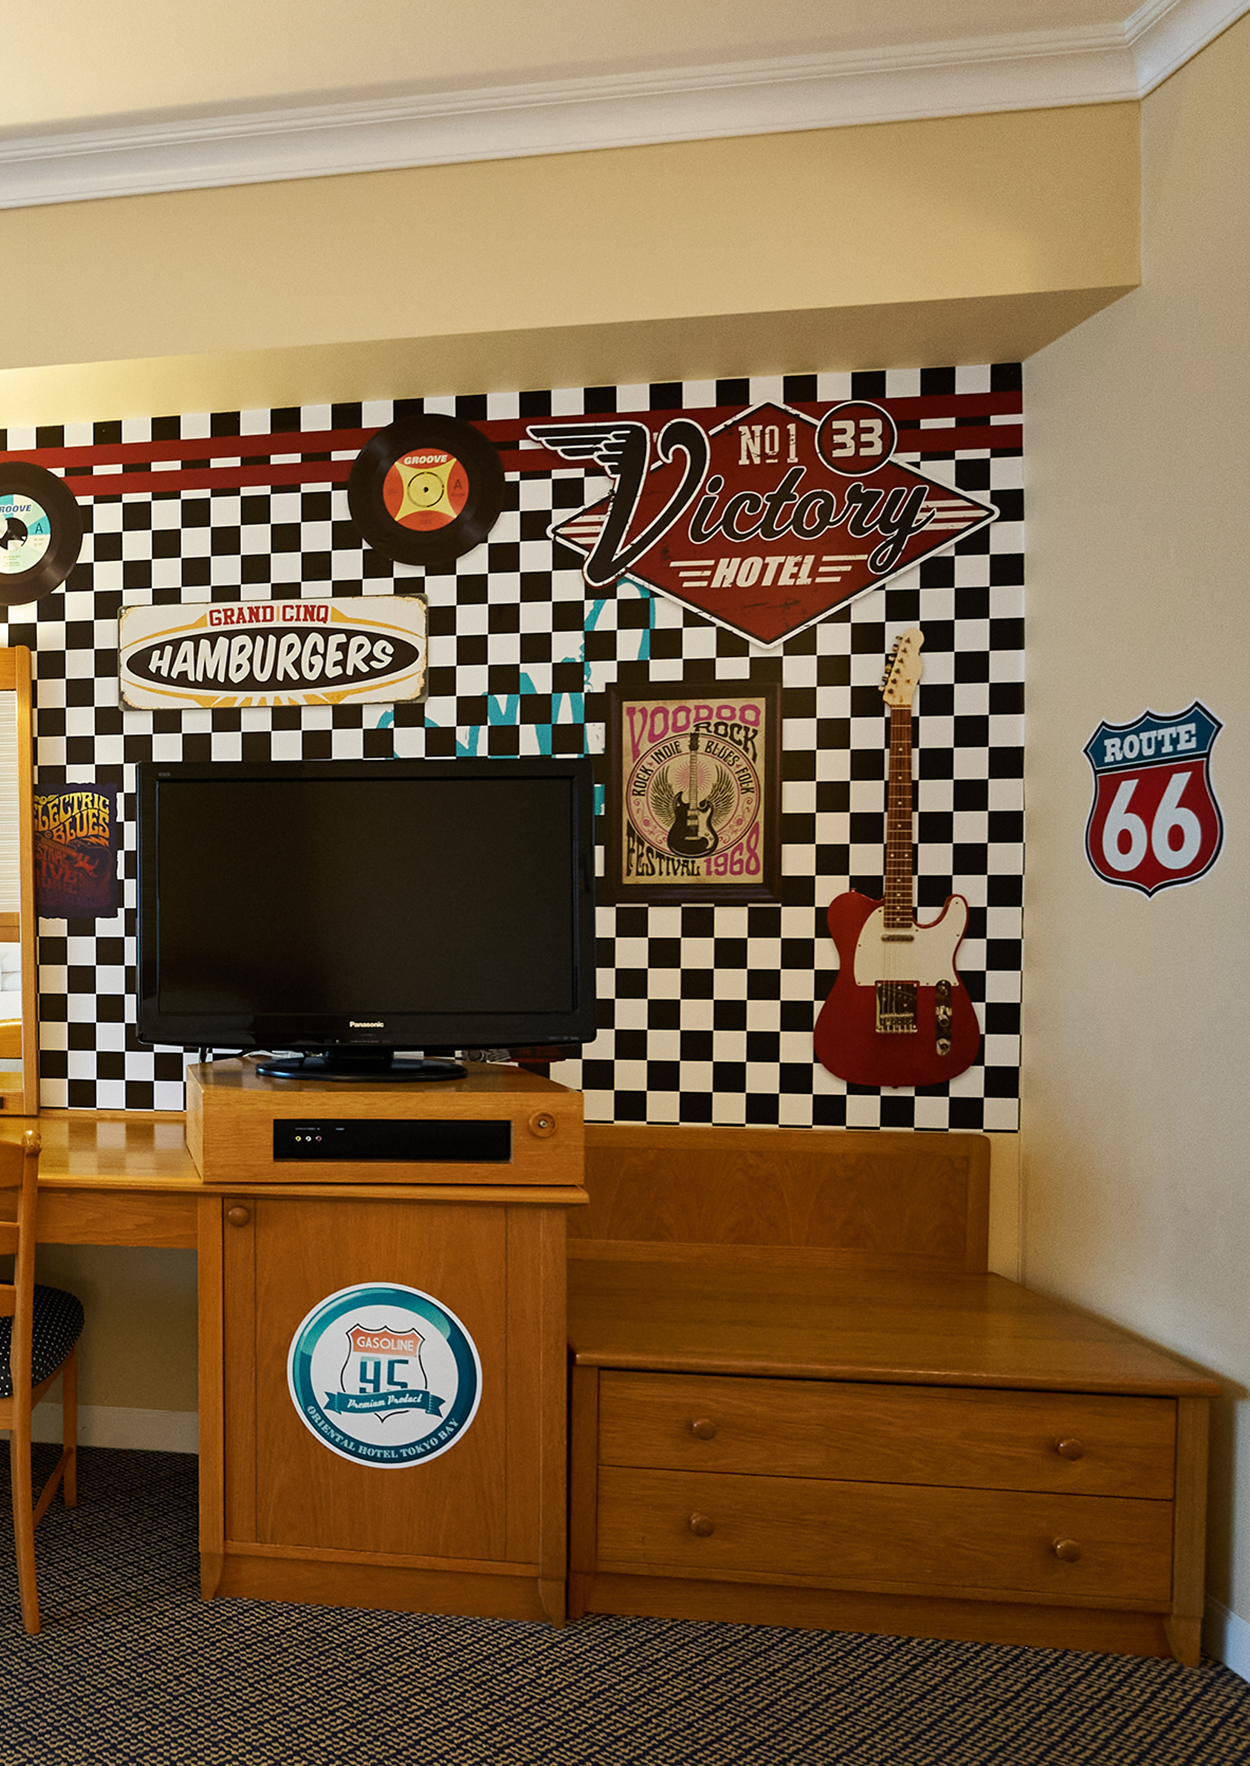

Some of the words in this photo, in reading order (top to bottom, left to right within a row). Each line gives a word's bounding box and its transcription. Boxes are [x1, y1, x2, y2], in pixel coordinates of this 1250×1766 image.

[831, 418, 883, 458] 33
[403, 454, 448, 465] GROOVE
[453, 478, 463, 491] A
[582, 418, 937, 587] Victory
[35, 522, 44, 534] A
[711, 554, 815, 589] HOTEL
[208, 605, 275, 627] GRAND
[281, 604, 330, 624] CINQ
[148, 632, 395, 684] HAMBURGERS
[626, 703, 762, 764] VOODOO
[693, 721, 758, 764] ROCK
[1103, 722, 1197, 763] ROUTE
[632, 765, 654, 797] ROCK
[650, 740, 683, 764] INDIE
[704, 740, 740, 767] BLUES
[734, 763, 756, 795] FOLK
[52, 808, 110, 845] BLUES
[1102, 770, 1202, 872] 66
[625, 818, 701, 877] FESTIVAL
[703, 821, 761, 877] 1968
[349, 1020, 385, 1028] Panasonic
[356, 1335, 414, 1352] GASOLINE
[347, 1398, 386, 1409] Premium
[387, 1393, 423, 1406] Product
[307, 1405, 356, 1452] ORIENTAL
[358, 1445, 399, 1459] HOTEL
[400, 1437, 439, 1458] TOKYO
[438, 1417, 460, 1441] BAY
